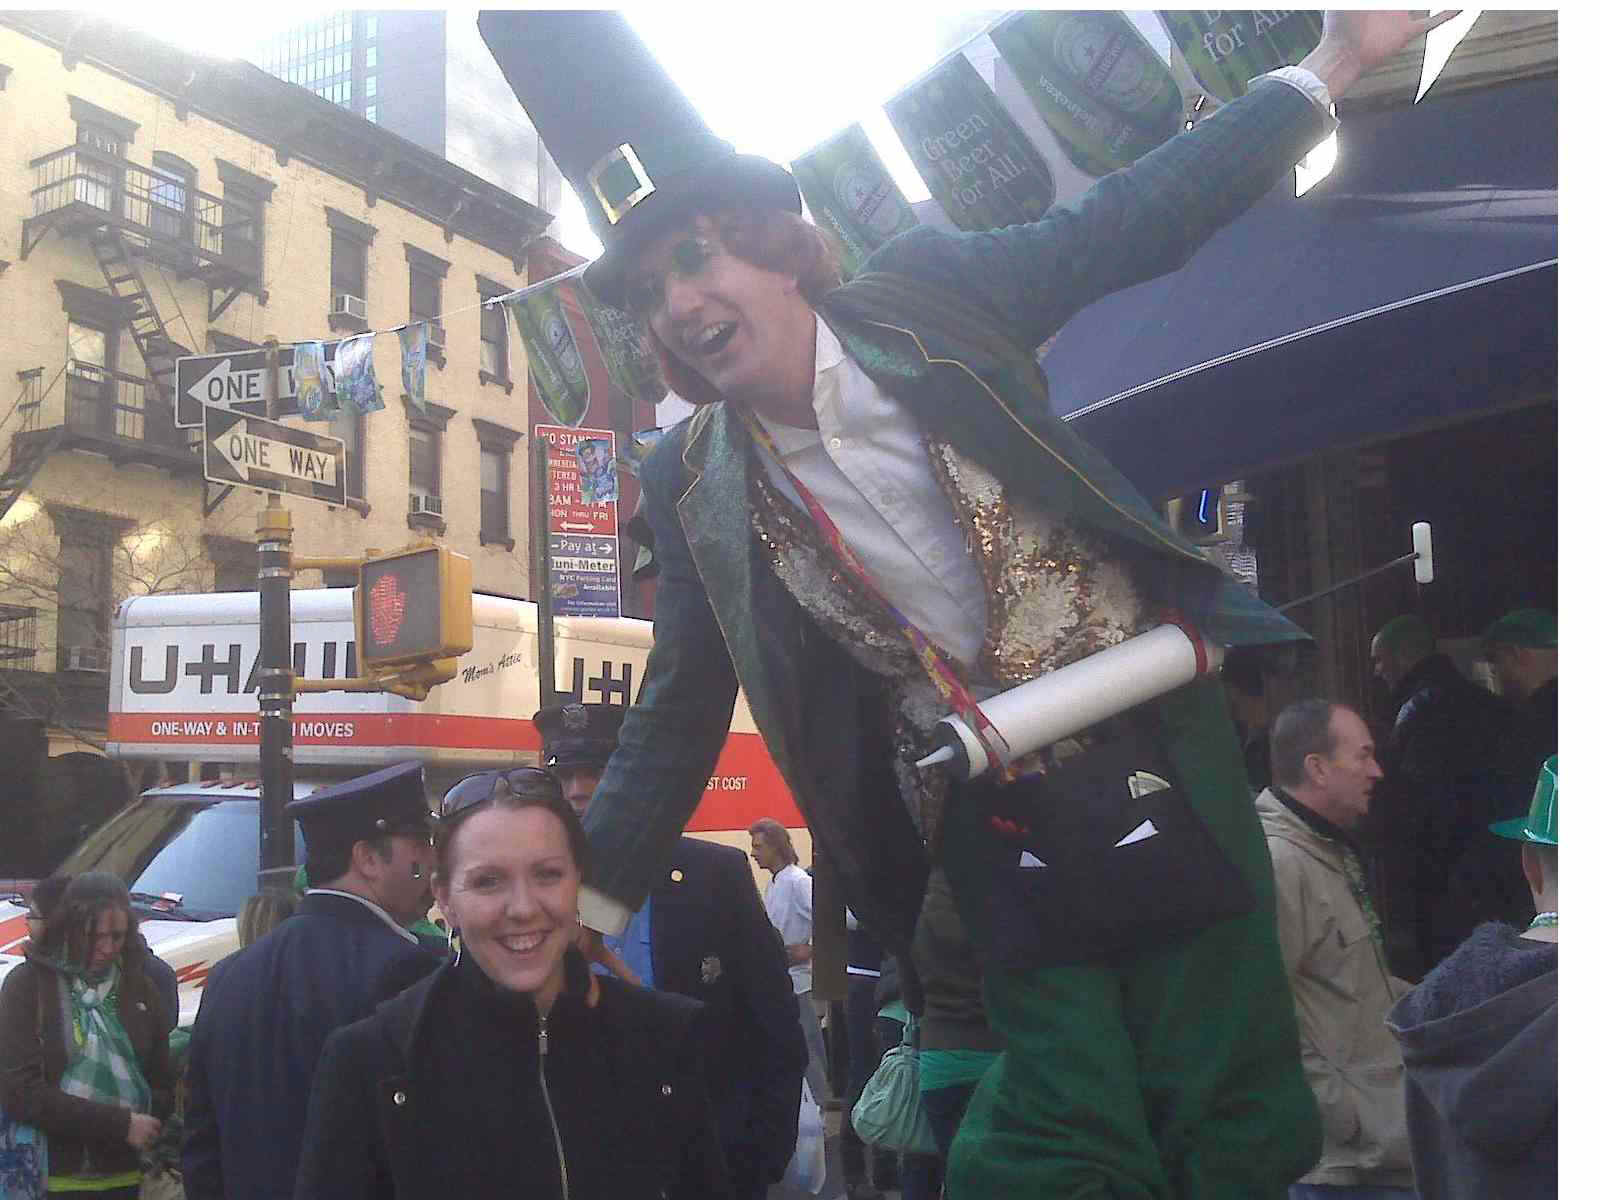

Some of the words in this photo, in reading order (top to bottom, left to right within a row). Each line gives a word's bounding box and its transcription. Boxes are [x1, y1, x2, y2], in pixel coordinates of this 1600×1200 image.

[1204, 23, 1246, 62] for
[921, 113, 989, 162] Green
[939, 143, 995, 182] Beer
[951, 183, 987, 210] for
[985, 155, 1027, 190] All.
[207, 372, 261, 402] ONE
[229, 433, 272, 469] ONE
[289, 447, 328, 481] WAY
[561, 540, 581, 554] Pay
[585, 543, 597, 552] at
[553, 560, 615, 571] uni-Meter
[151, 721, 213, 737] ONE-WAY
[216, 721, 228, 737] &
[300, 722, 354, 738] MOVES
[721, 777, 748, 791] COST
